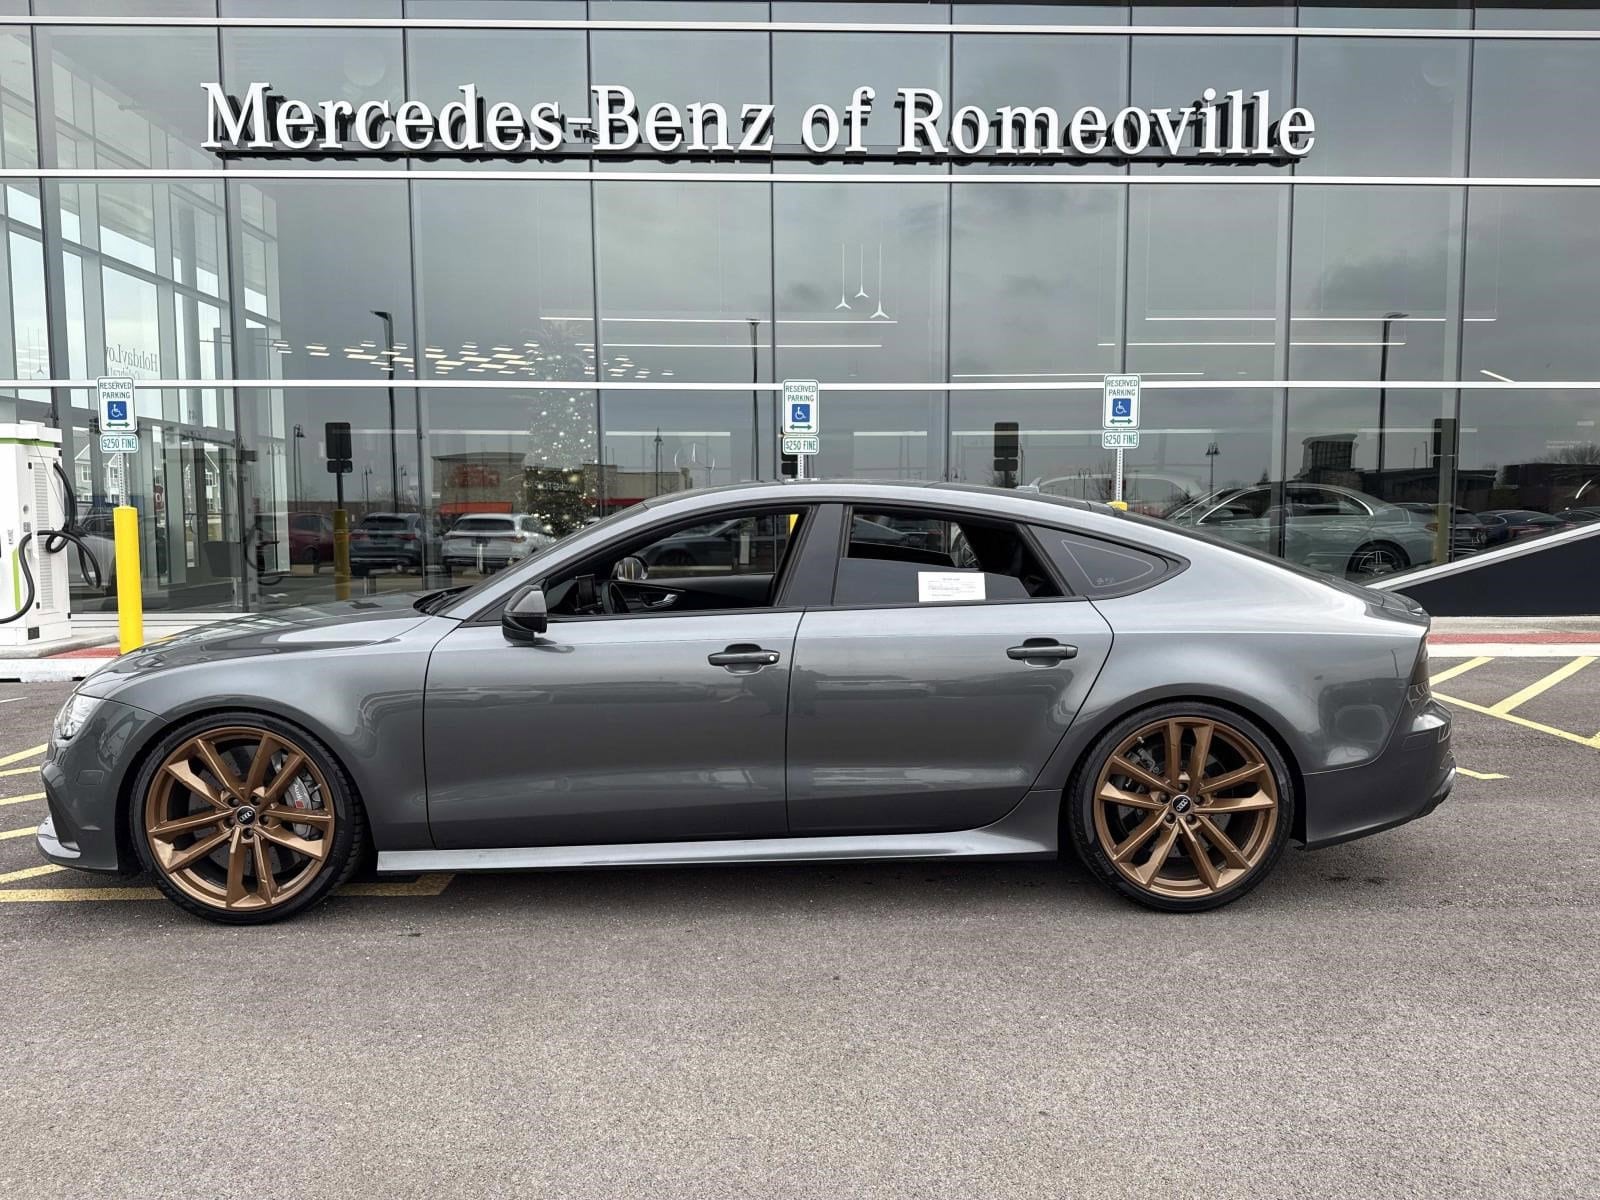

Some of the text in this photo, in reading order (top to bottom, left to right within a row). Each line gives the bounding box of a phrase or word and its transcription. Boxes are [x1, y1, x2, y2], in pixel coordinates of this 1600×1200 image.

[200, 81, 1316, 156] Mercedes-Benz of Romeoville
[99, 382, 132, 390] RESERVED
[1106, 379, 1137, 387] RESERVED
[785, 385, 816, 393] RESERVED
[1108, 389, 1136, 397] PARKING
[102, 391, 130, 399] PARKING
[787, 394, 815, 402] PARKING
[1105, 434, 1137, 445] $250 FINE
[103, 439, 136, 449] $250 FINE
[785, 440, 816, 451] $250 FINE
